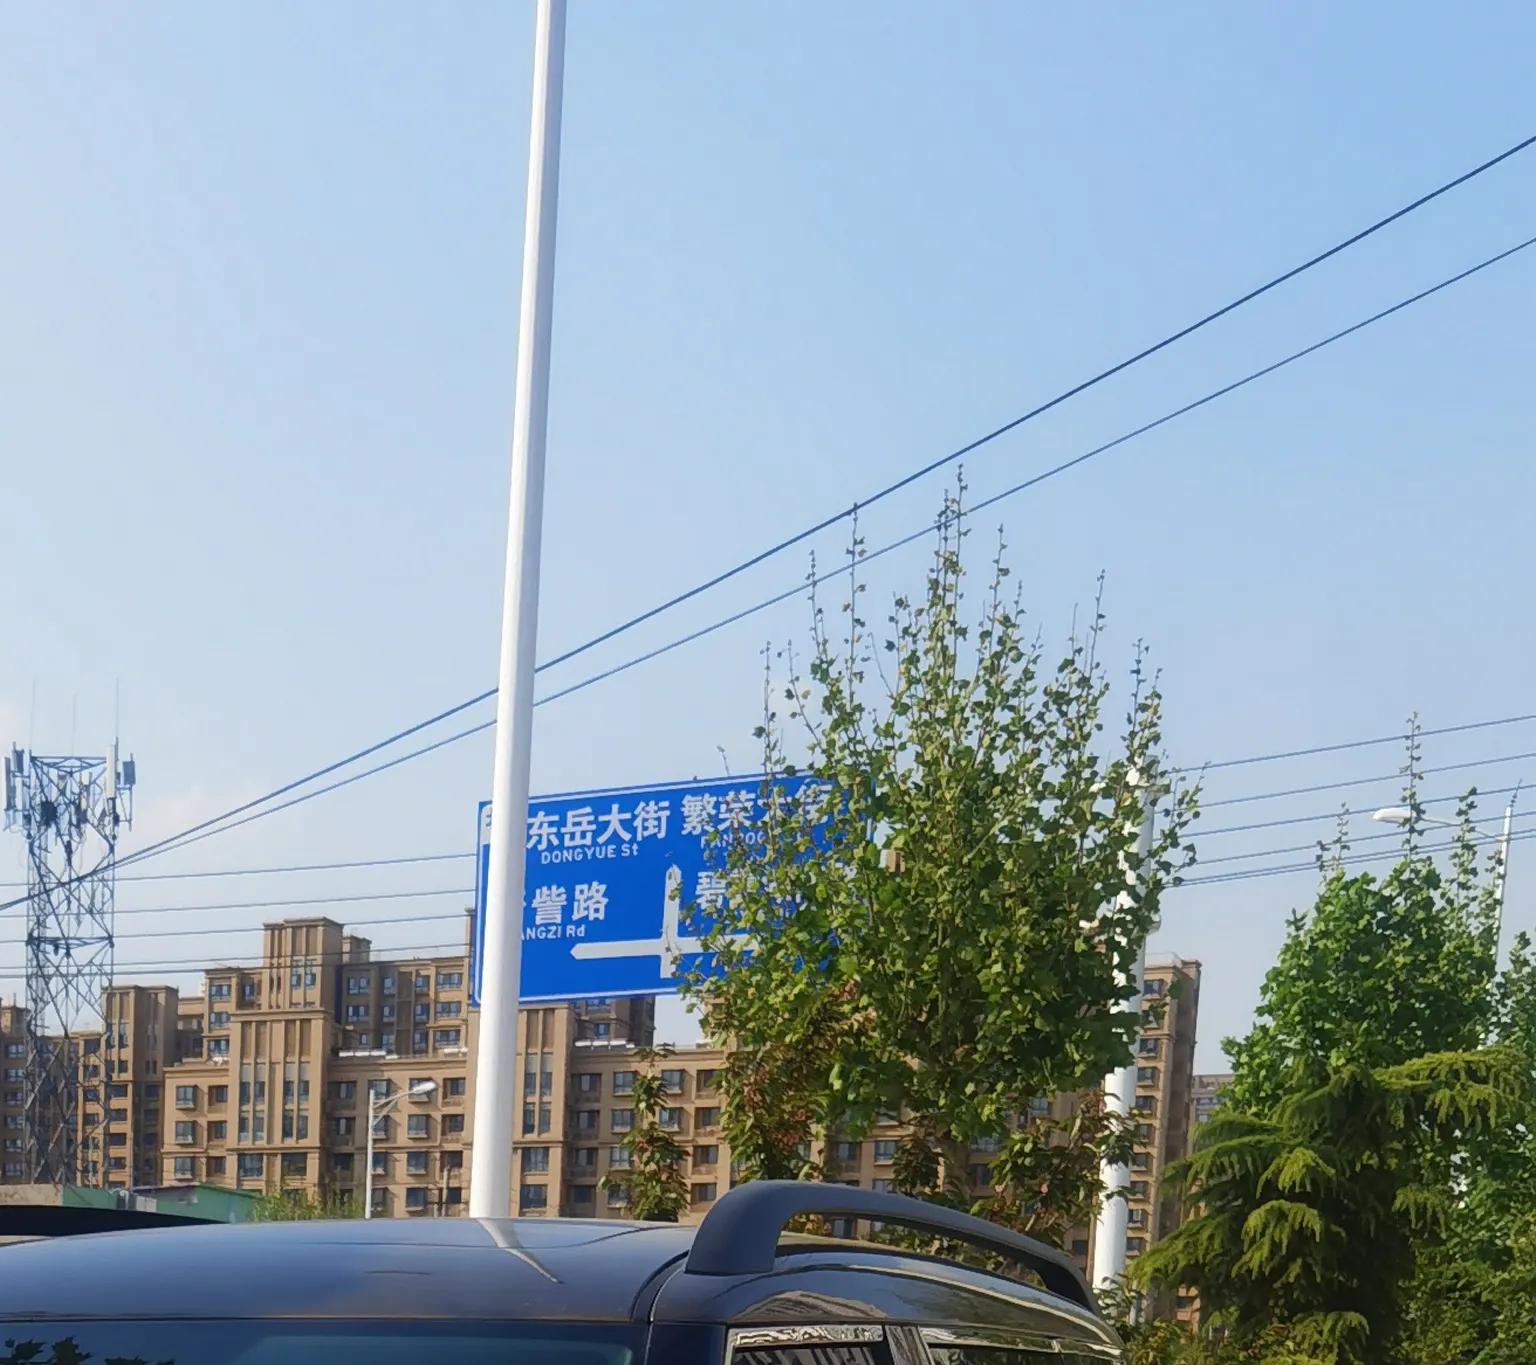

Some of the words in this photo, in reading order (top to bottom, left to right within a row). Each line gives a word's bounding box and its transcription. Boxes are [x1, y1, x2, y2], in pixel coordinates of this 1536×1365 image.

[526, 800, 670, 850] 东岳大街
[541, 845, 617, 864] DONGYUE
[621, 843, 639, 857] St
[566, 924, 586, 938] Rd
